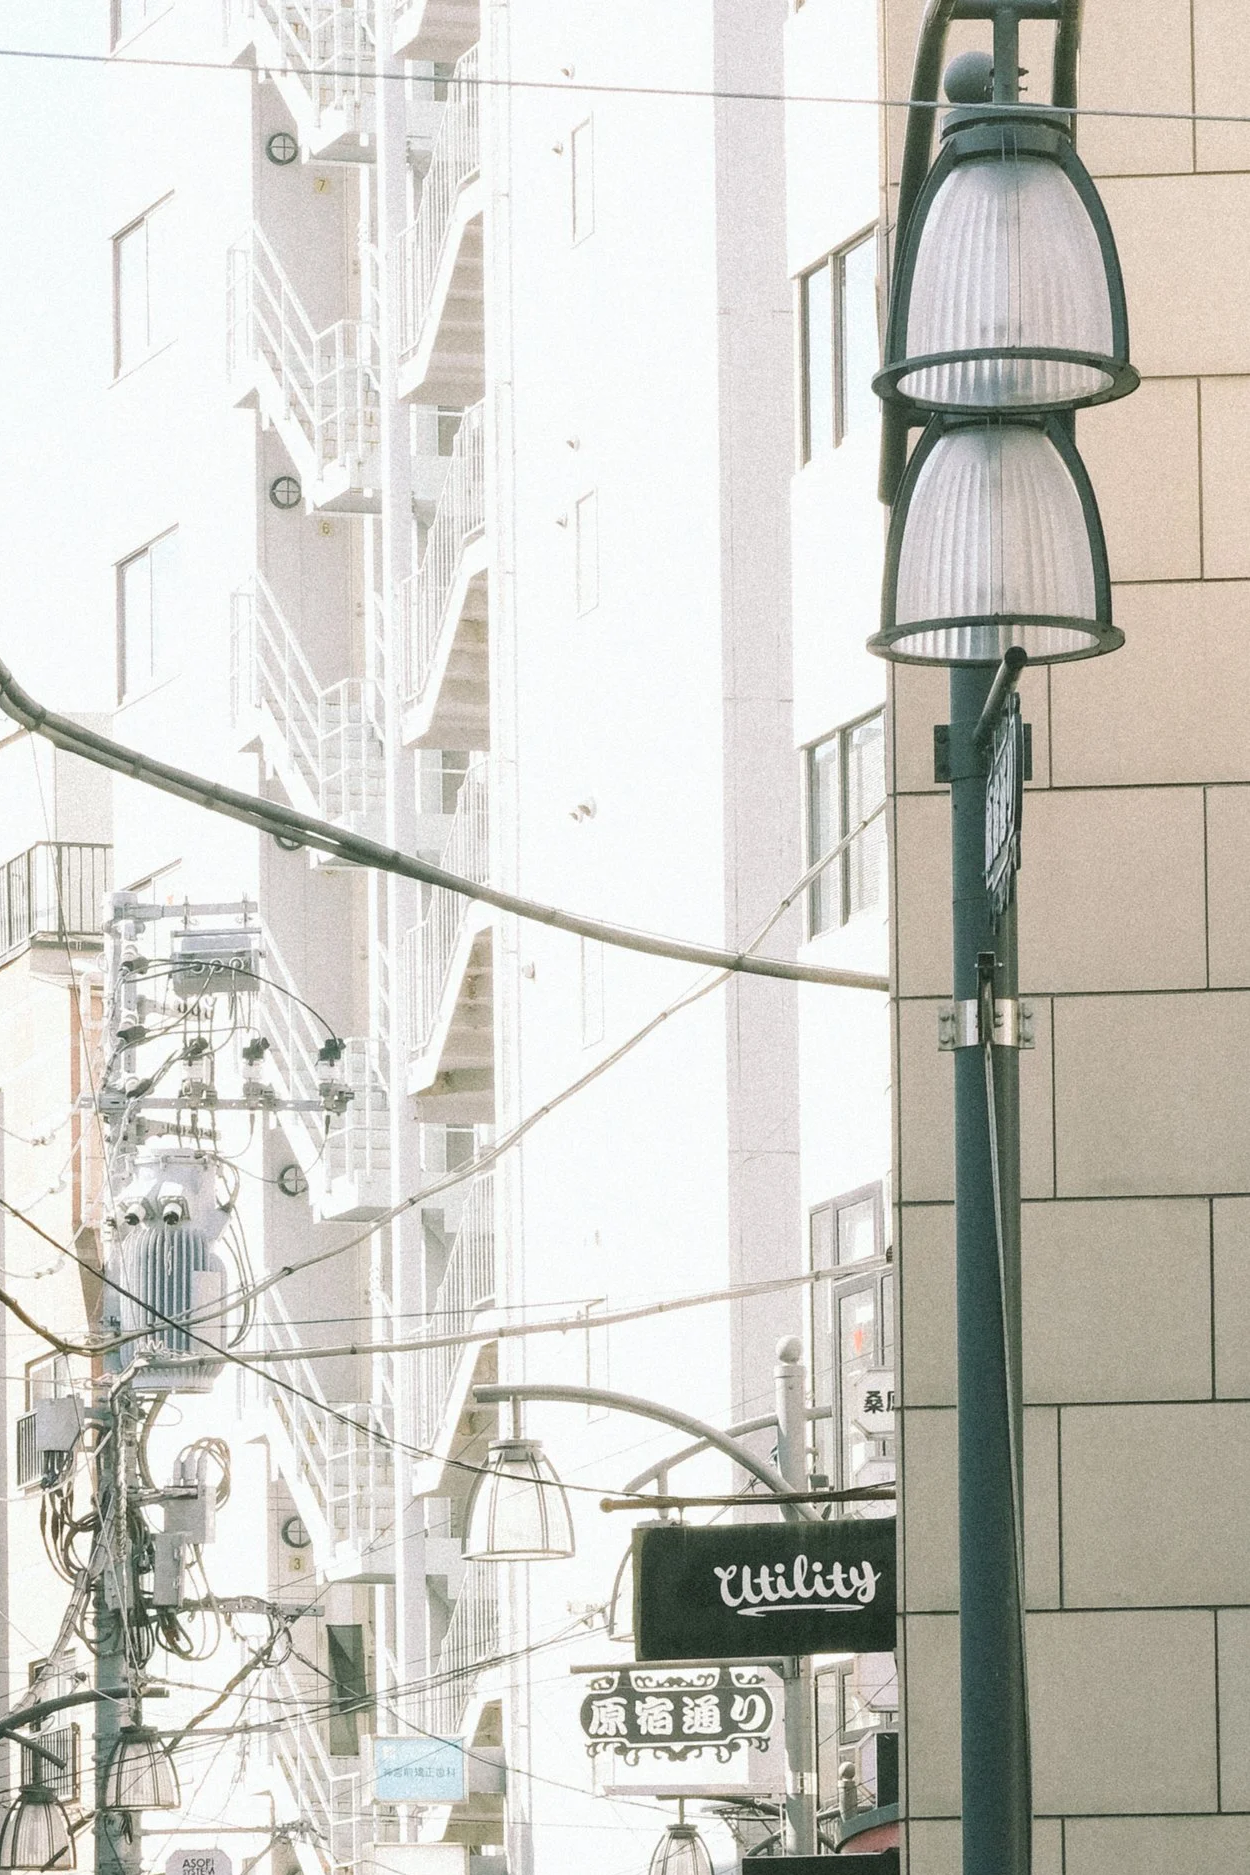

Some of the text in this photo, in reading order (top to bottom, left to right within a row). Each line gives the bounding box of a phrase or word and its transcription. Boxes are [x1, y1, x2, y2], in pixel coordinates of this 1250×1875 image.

[713, 1554, 882, 1608] Utility
[588, 1694, 766, 1736] 原宿通り
